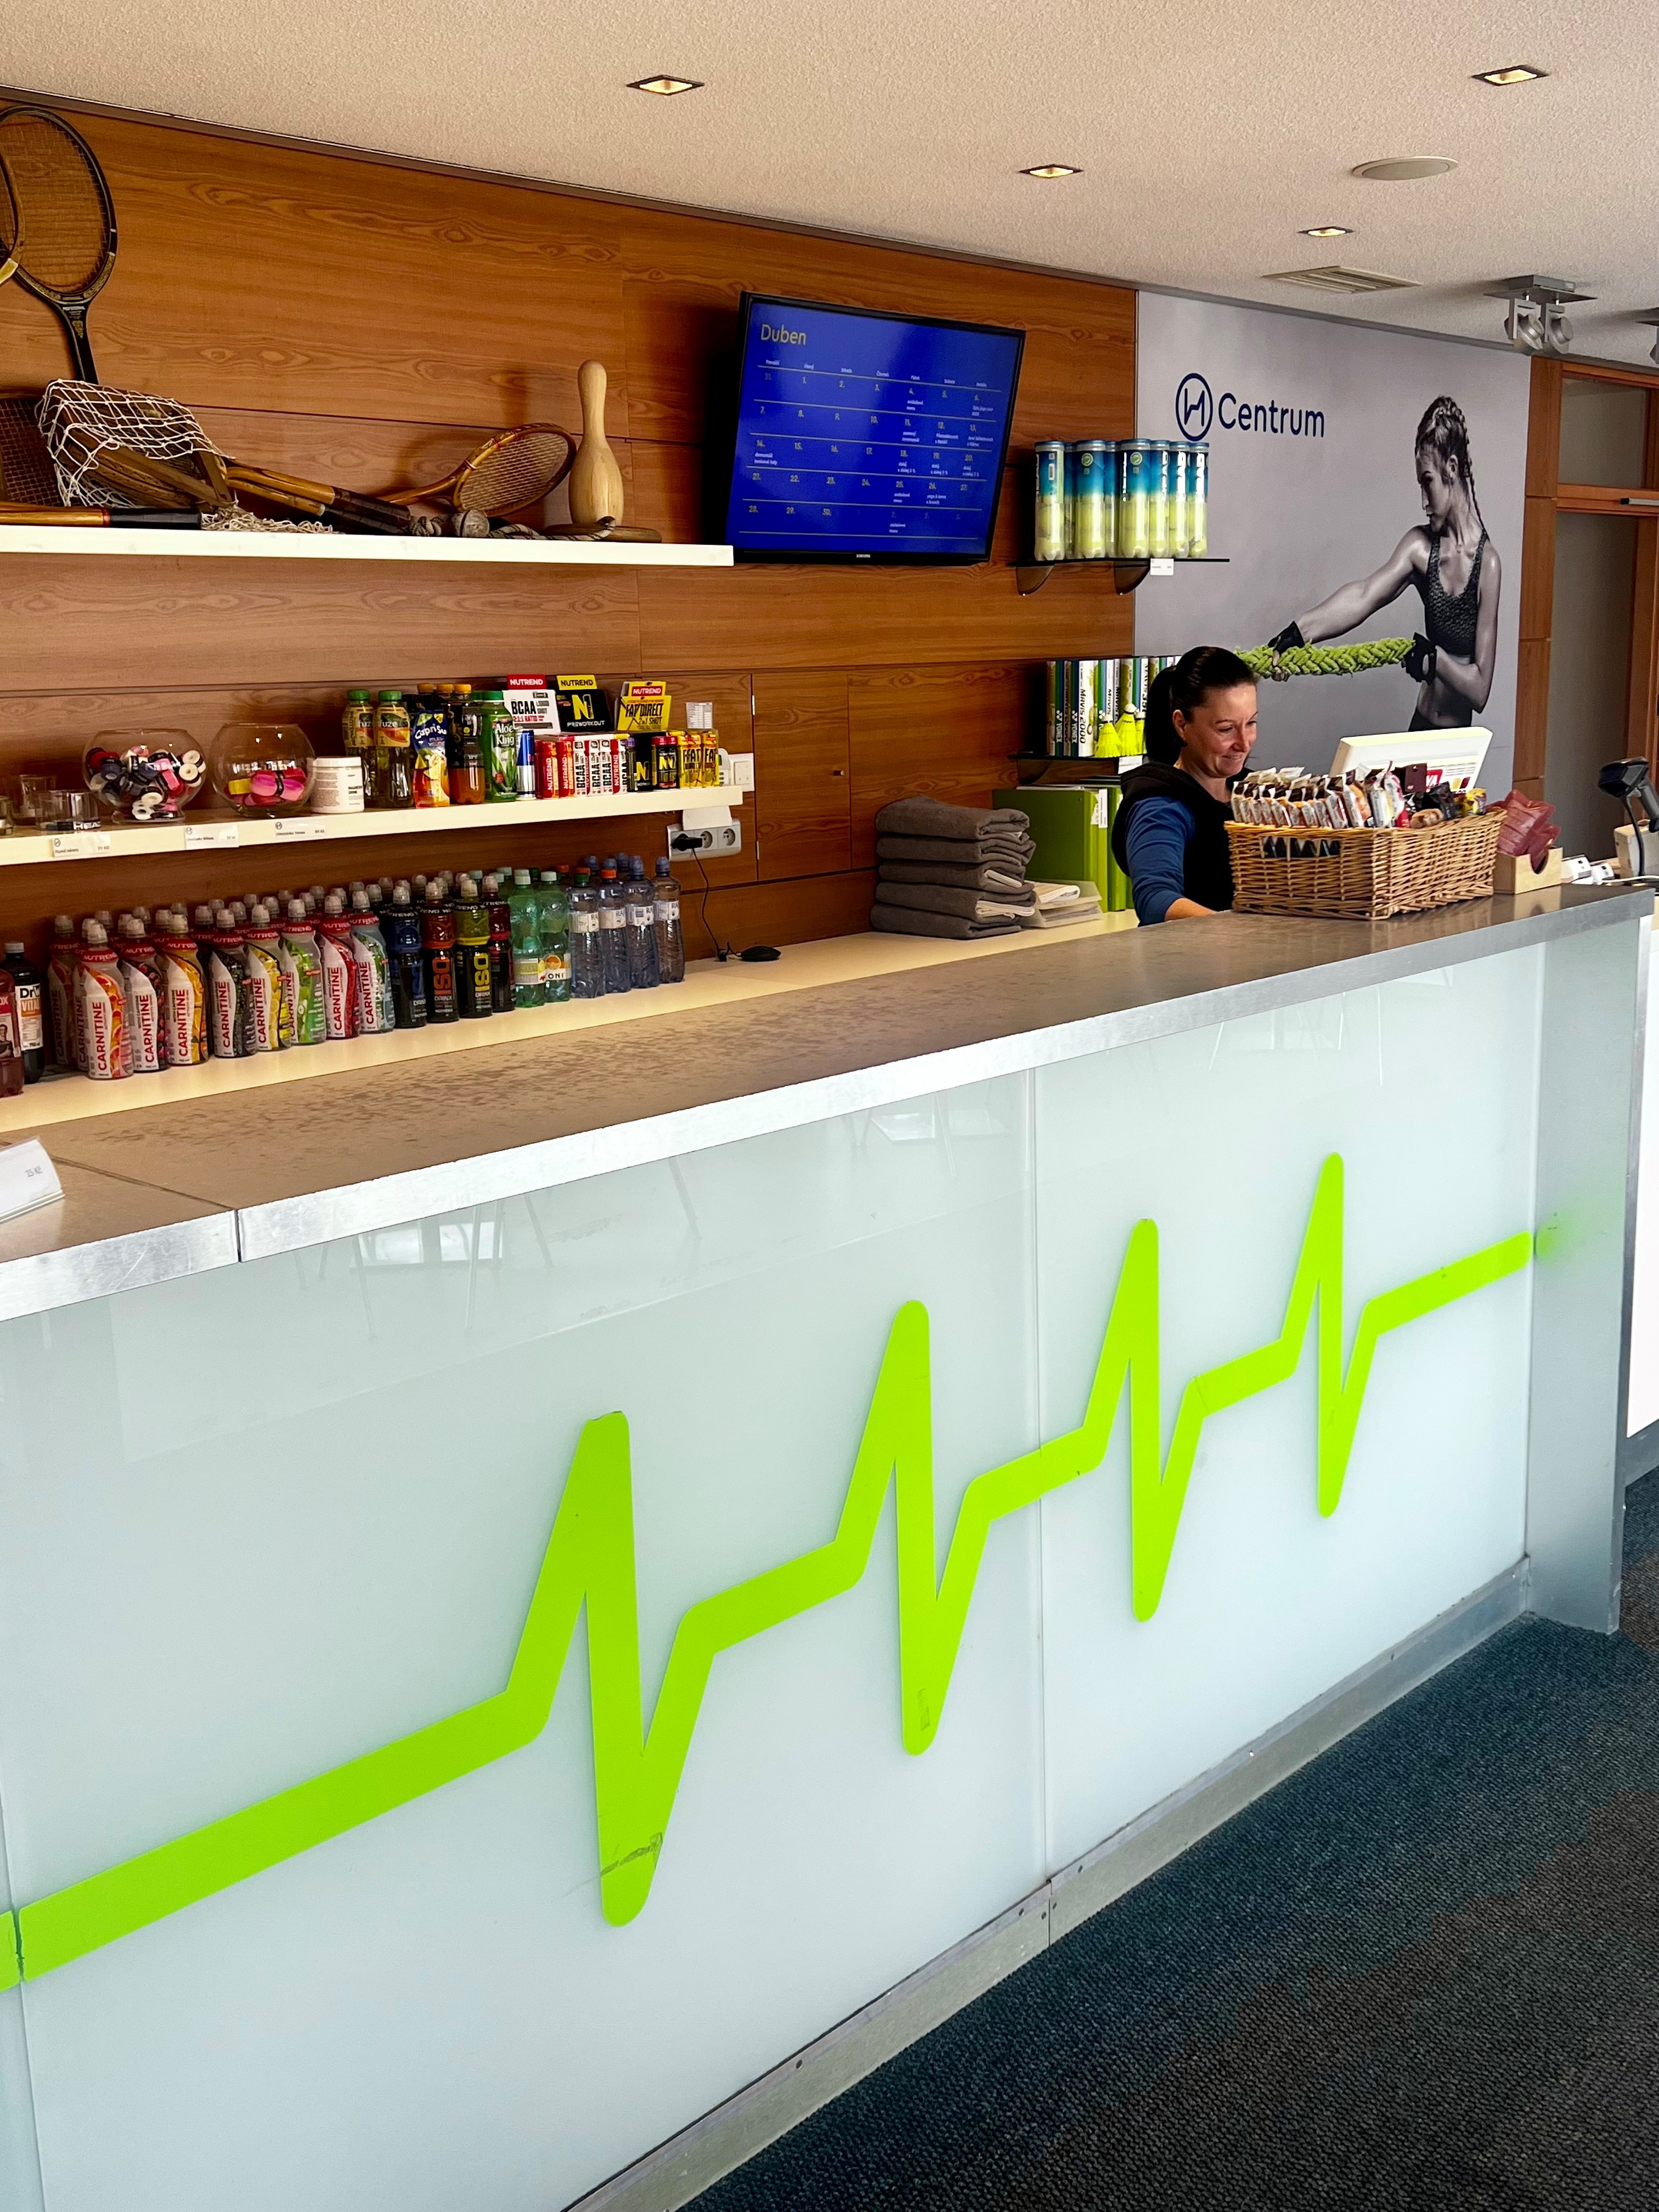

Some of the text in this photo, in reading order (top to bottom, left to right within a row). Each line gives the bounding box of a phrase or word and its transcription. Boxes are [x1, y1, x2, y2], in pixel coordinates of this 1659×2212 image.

[761, 324, 806, 345] Duben
[1218, 392, 1324, 438] Centrum
[495, 723, 514, 734] Aloe
[511, 701, 537, 715] BCAA
[496, 734, 515, 746] King
[575, 765, 586, 788] BCAA
[360, 961, 374, 1024] CARNITINE
[432, 957, 452, 995] ISO
[474, 952, 491, 992] ISO
[218, 981, 230, 1048] CARNITINE
[253, 978, 267, 1043] CARNITINE
[331, 967, 342, 1030] CARNITINE
[92, 1001, 107, 1071] CARNITINE
[139, 994, 155, 1063] CARNITINE
[176, 989, 188, 1057] CARNITINE
